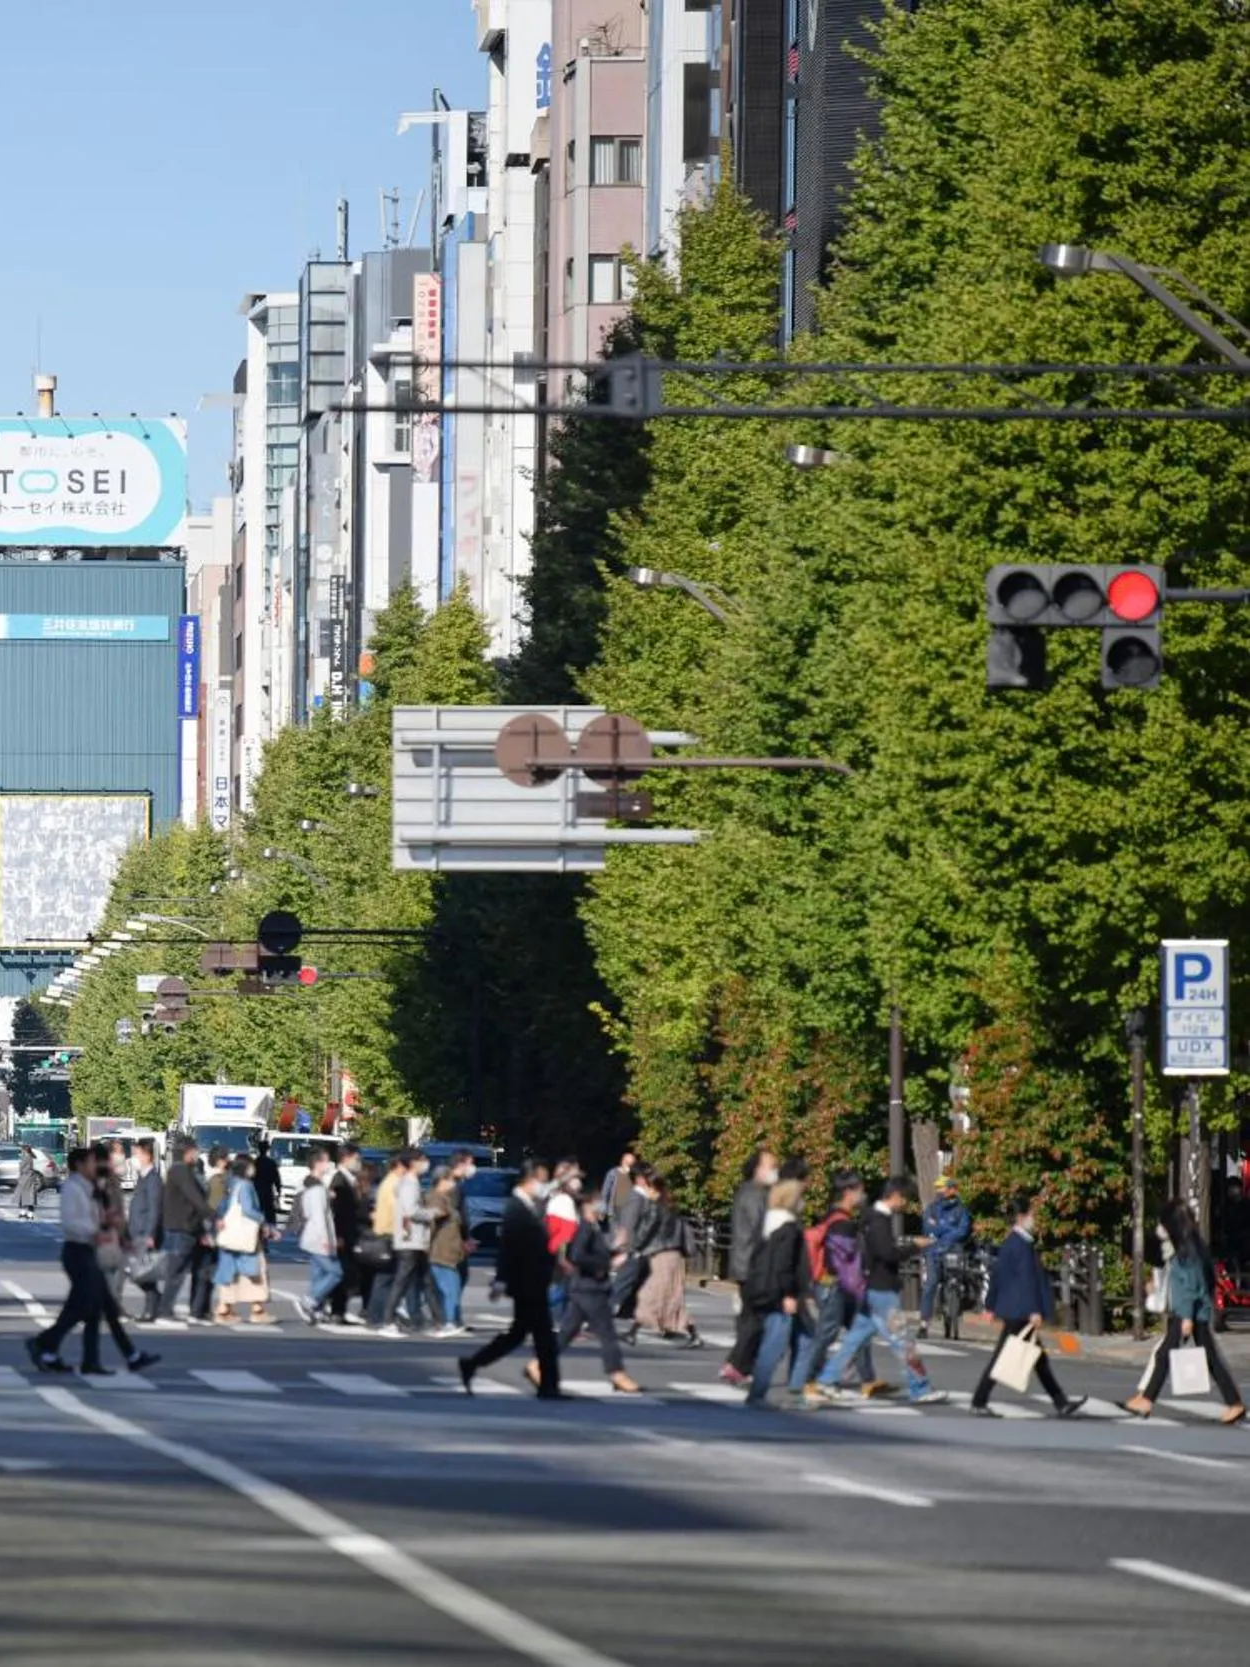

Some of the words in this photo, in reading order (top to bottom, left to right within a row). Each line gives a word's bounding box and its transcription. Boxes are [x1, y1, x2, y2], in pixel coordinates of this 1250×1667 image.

[1175, 953, 1212, 1000] P
[1189, 988, 1217, 1000] 24H
[1177, 1041, 1213, 1053] UDX
